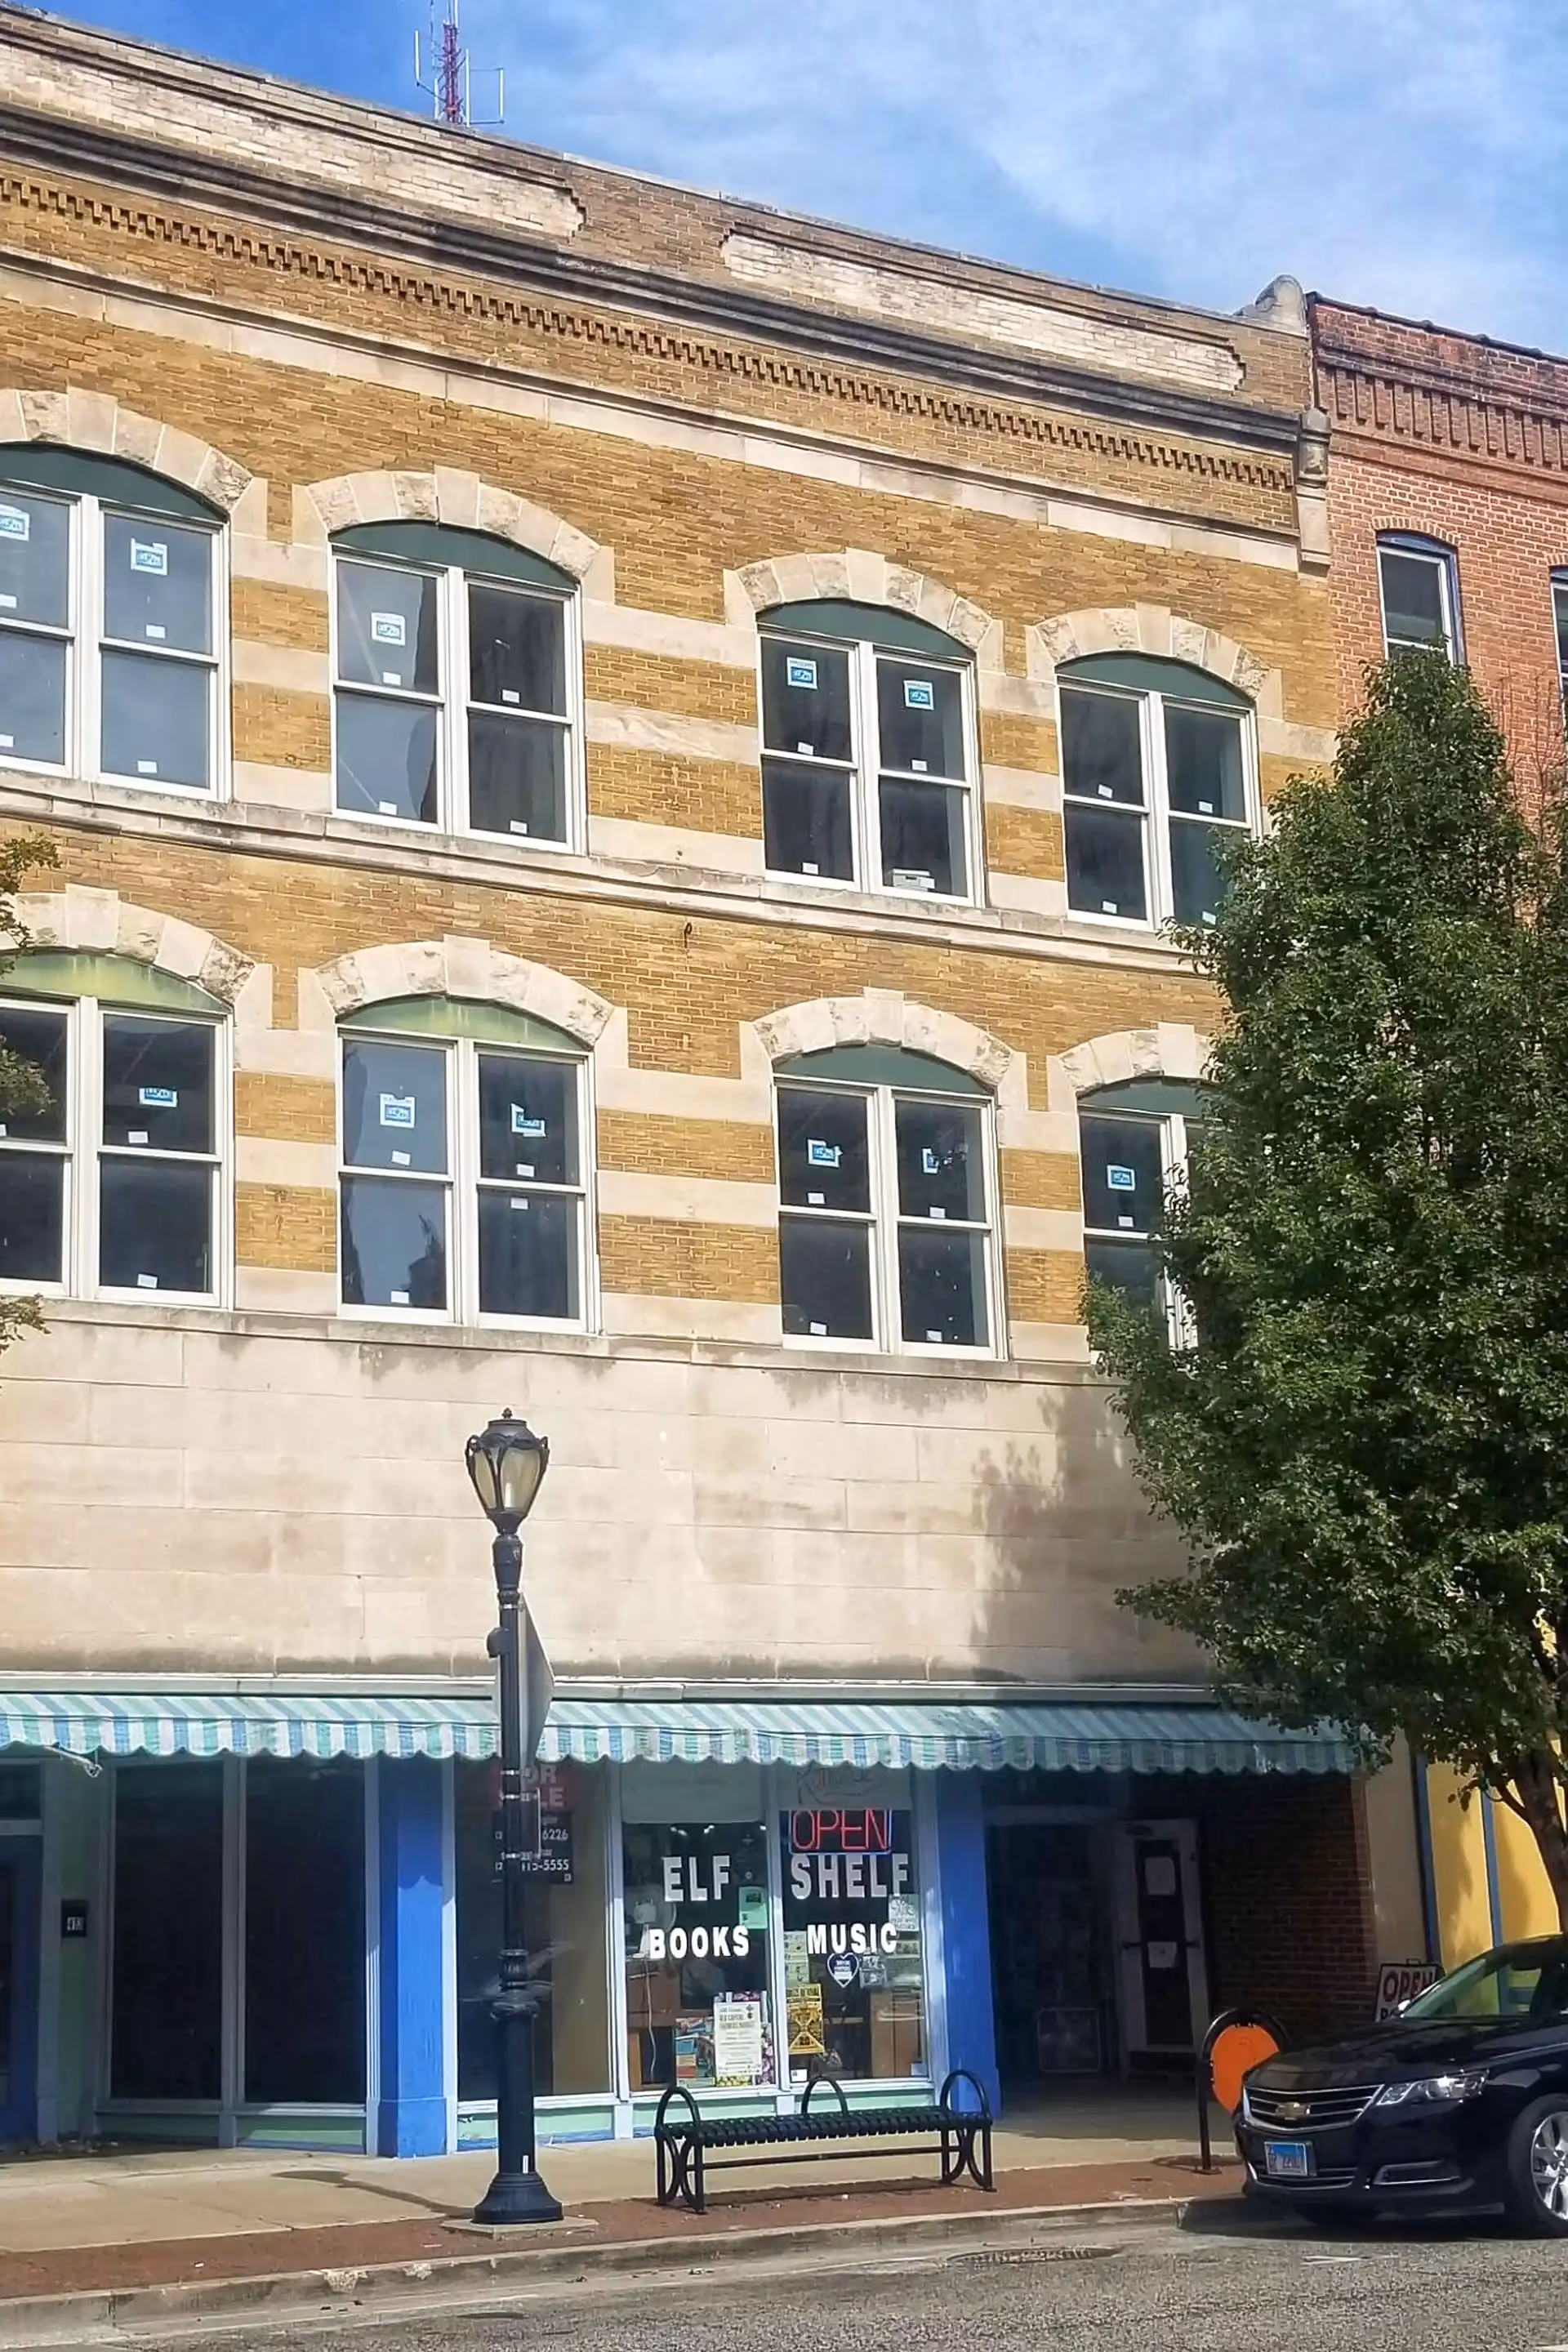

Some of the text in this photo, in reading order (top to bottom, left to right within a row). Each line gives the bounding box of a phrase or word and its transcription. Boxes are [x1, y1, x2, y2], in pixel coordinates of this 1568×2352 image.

[792, 1808, 888, 1850] OPEN
[662, 1852, 909, 1902] ELF SHELF
[649, 1922, 898, 1959] BOOKS MUSIC
